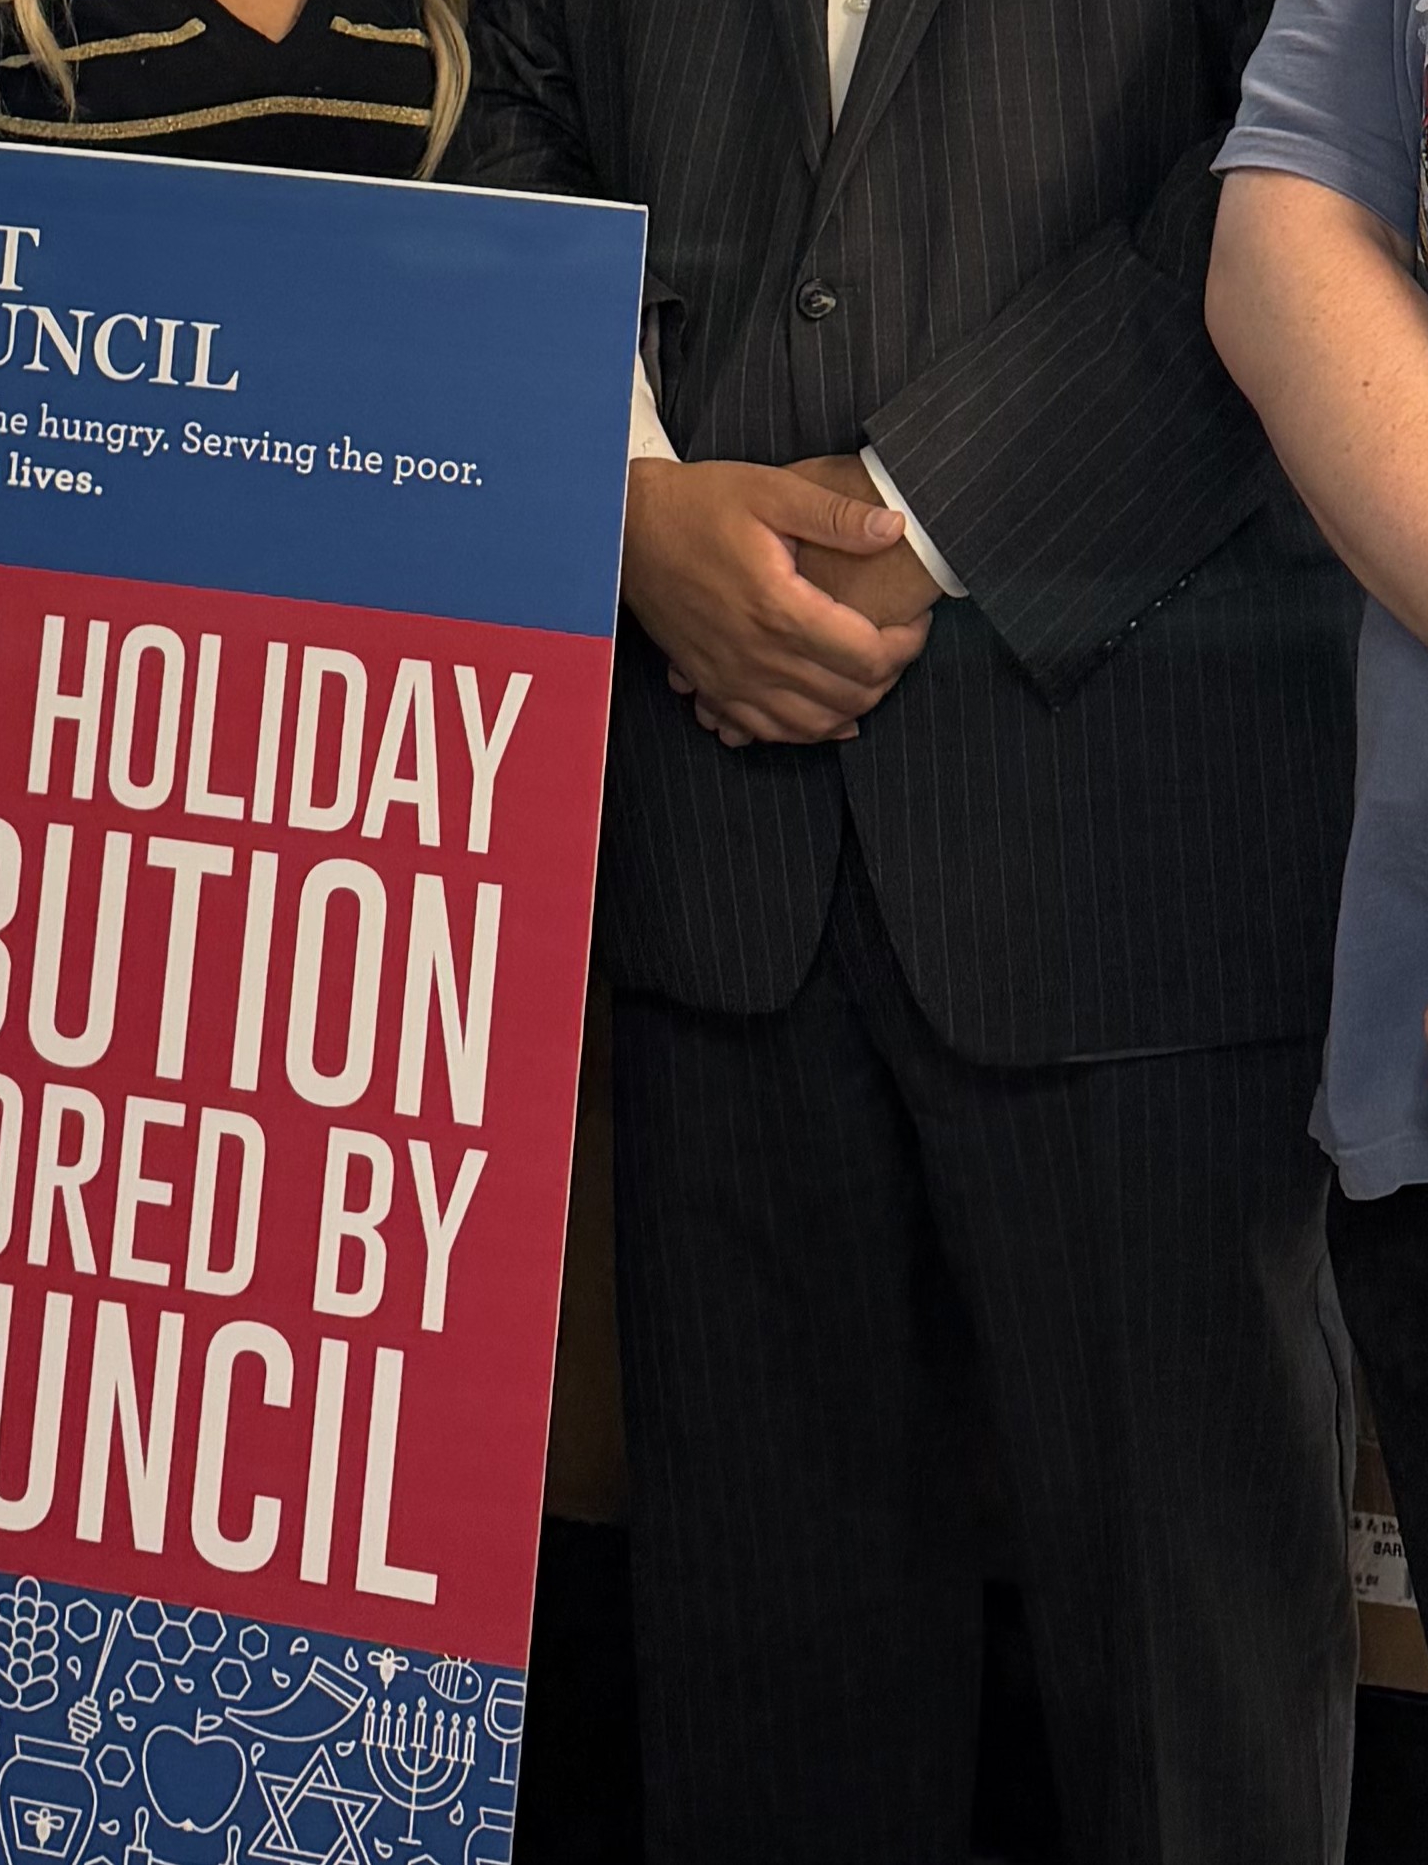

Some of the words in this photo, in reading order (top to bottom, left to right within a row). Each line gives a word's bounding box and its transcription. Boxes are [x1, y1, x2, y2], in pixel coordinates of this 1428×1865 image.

[8, 452, 102, 494] lives.
[39, 403, 170, 456] hungry.
[182, 422, 317, 473] Serving
[328, 436, 382, 473] the
[392, 450, 484, 487] poor.
[28, 615, 532, 853] HOLIDAY
[313, 1127, 488, 1332] BY
